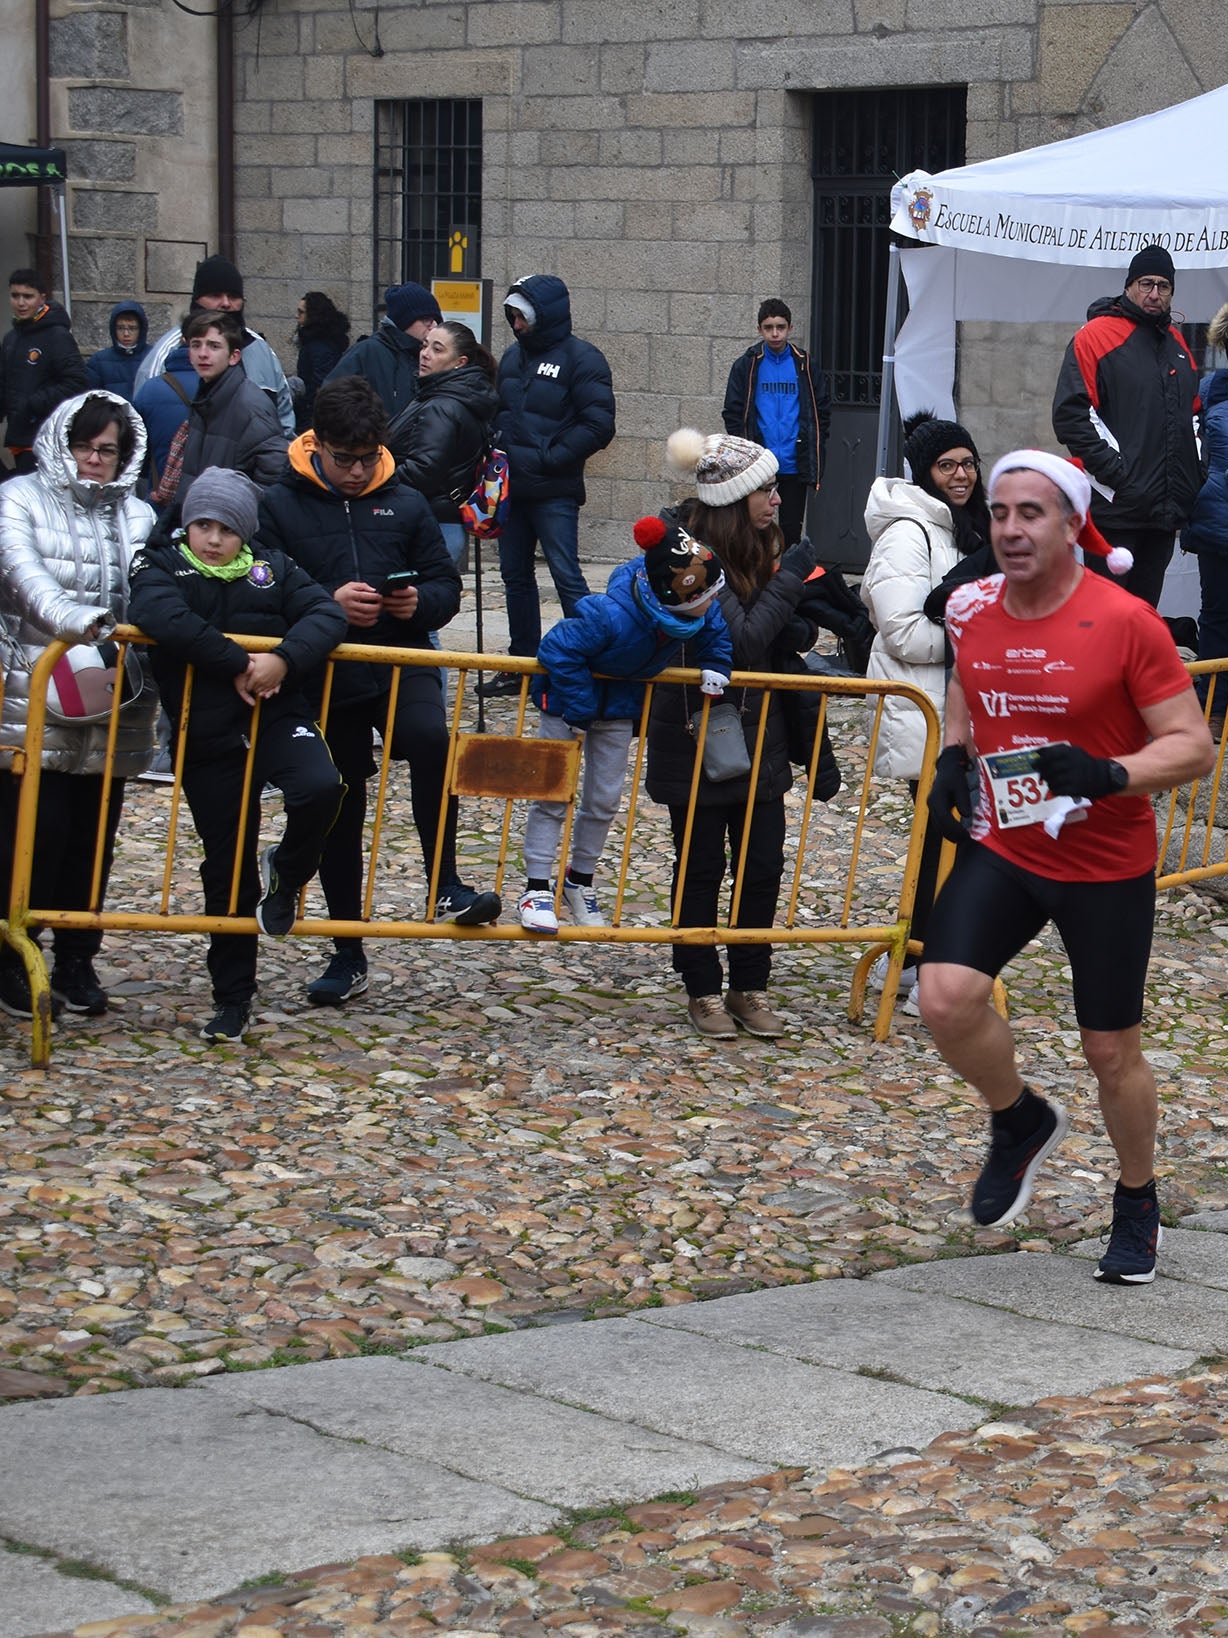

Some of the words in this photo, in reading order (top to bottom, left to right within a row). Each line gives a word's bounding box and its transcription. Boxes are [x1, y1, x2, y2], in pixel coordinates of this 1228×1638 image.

[934, 204, 991, 237] ESCUELA
[994, 213, 1065, 247] MUNICIPAL
[1068, 228, 1088, 249] DE
[1089, 225, 1171, 252] ATLETISMO
[1174, 232, 1195, 252] DE
[537, 362, 561, 378] HH
[762, 382, 796, 394] PUMA
[373, 508, 395, 516] FILA
[979, 689, 1011, 717] VI
